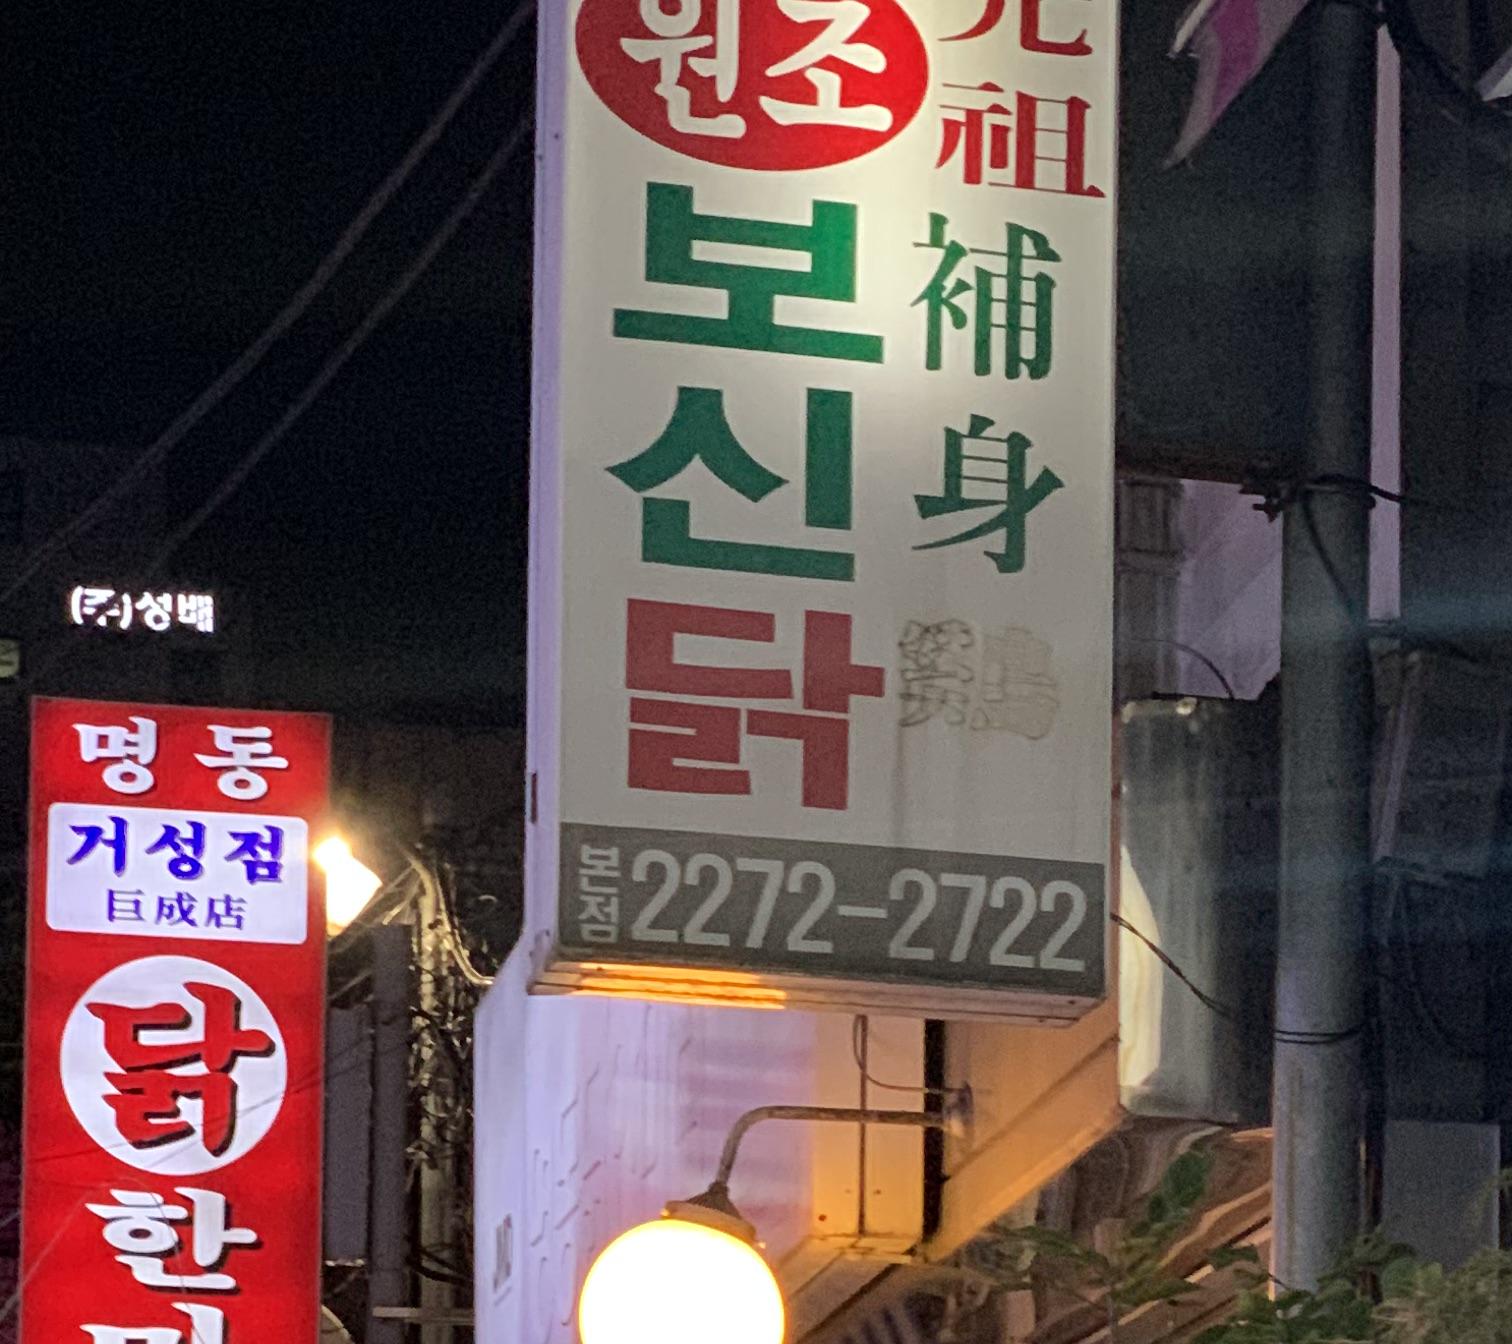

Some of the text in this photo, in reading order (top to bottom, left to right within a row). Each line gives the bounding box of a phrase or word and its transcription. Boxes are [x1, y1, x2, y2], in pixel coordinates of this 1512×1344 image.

[621, 0, 893, 137] 원조
[605, 181, 886, 811] 보신닭
[73, 716, 290, 802] 명동
[66, 815, 285, 885] 거성점
[105, 887, 248, 930] 巨成店
[578, 845, 1088, 974] 본점 2272-2722
[85, 981, 276, 1159] 닭
